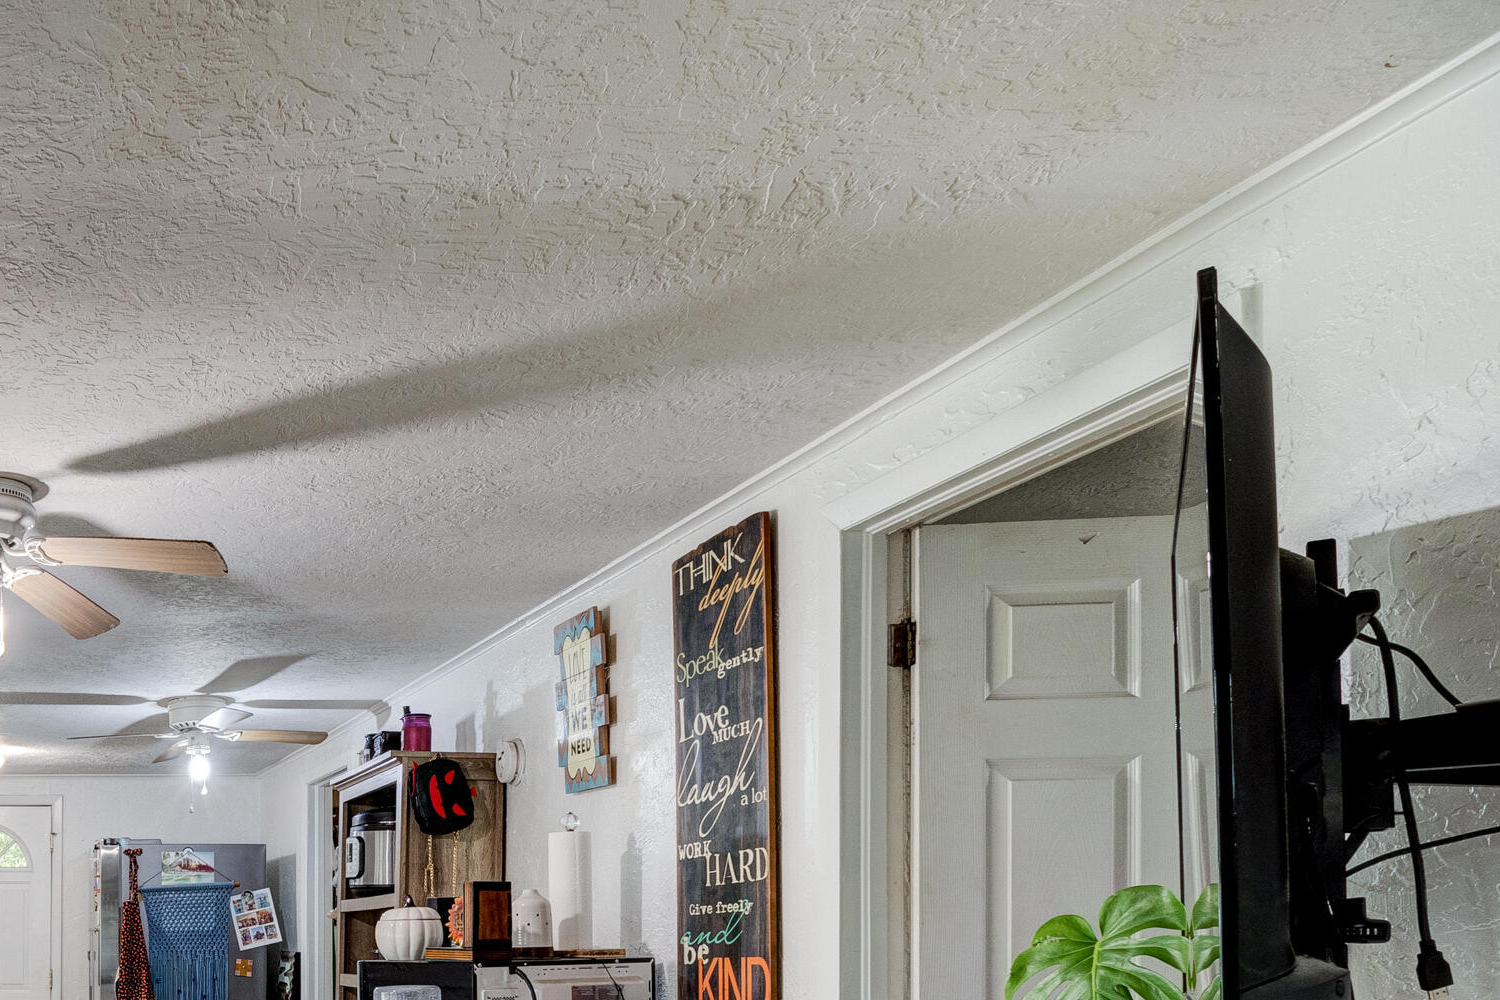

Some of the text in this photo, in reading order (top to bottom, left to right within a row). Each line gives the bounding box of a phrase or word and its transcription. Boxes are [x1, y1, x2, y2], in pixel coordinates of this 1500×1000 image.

[674, 532, 745, 596] THINK
[698, 540, 764, 649] deeply
[676, 636, 724, 688] Speak
[717, 646, 764, 680] gently
[572, 706, 588, 731] WE
[678, 697, 729, 743] Love
[711, 720, 751, 745] MUCH
[570, 737, 591, 756] NEED
[678, 717, 762, 838] laugh
[741, 787, 768, 806] a lot
[678, 840, 712, 860] WORK
[705, 847, 769, 887] HARD
[680, 899, 749, 945] and
[689, 901, 713, 916] Give
[716, 899, 754, 915] freely
[683, 937, 710, 965] be
